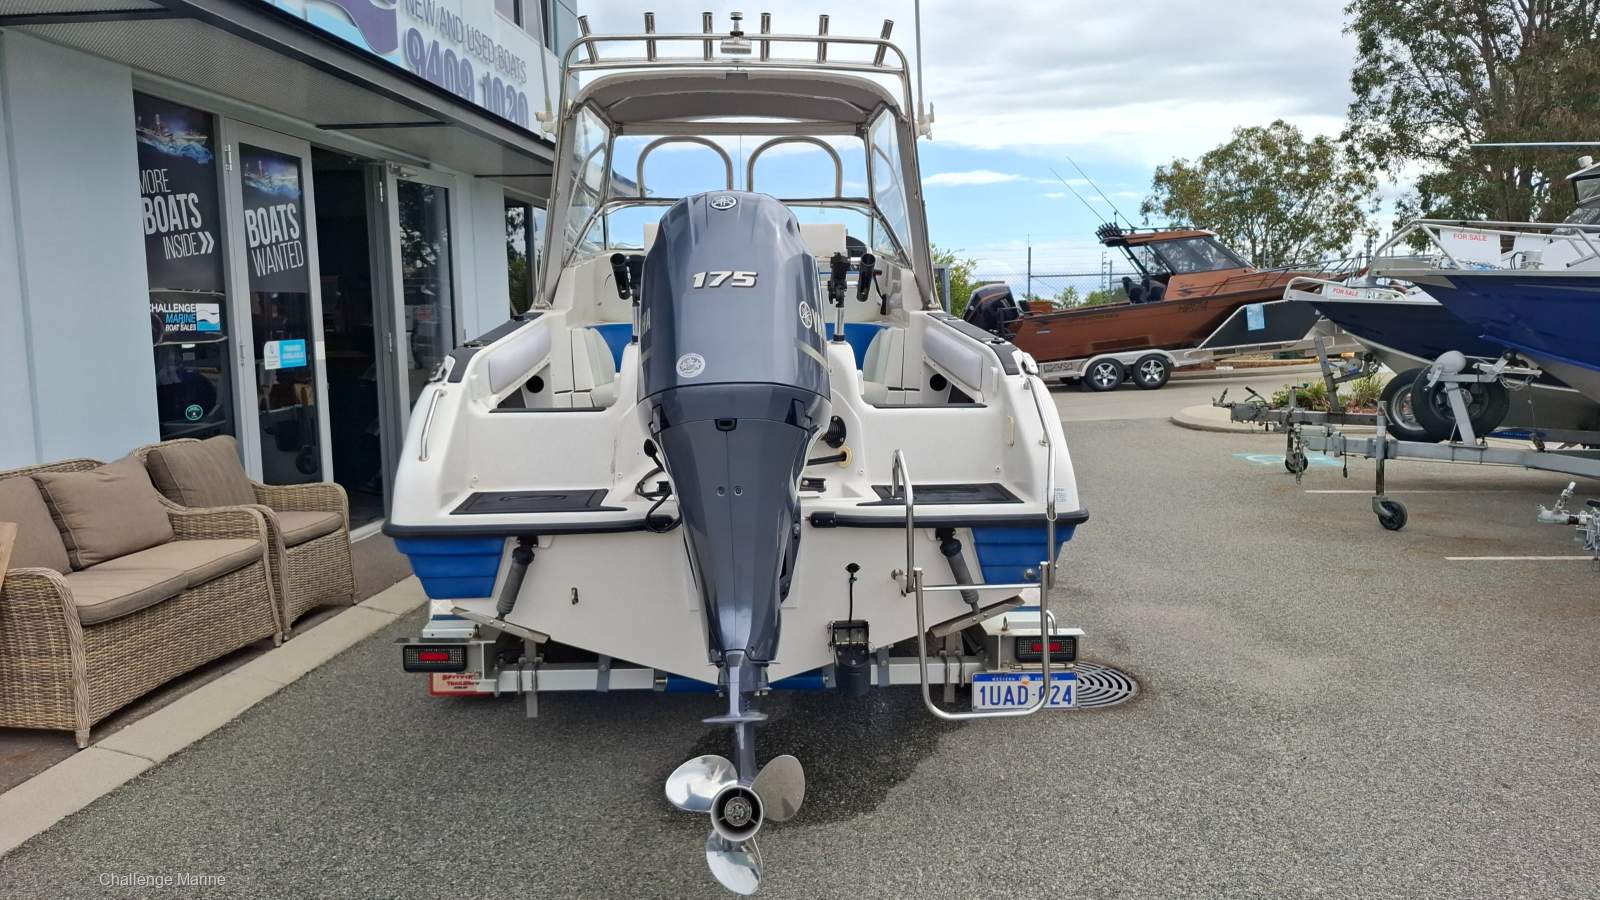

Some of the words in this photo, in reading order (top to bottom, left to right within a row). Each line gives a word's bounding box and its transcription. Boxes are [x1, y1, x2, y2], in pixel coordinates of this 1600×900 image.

[405, 0, 435, 27] NEW
[440, 6, 463, 43] AND
[466, 24, 494, 63] USED
[498, 45, 527, 84] BOATS
[405, 27, 474, 102] 9409
[142, 192, 202, 235] BOATS
[244, 203, 300, 248] BOATS
[163, 232, 199, 260] INSIDE
[1453, 233, 1468, 241] FOR
[251, 241, 304, 277] WANTED
[693, 271, 758, 288] 175
[1333, 287, 1344, 295] FOR
[1344, 289, 1359, 297] SALE
[165, 324, 179, 332] BOAT
[166, 313, 196, 323] MARINE
